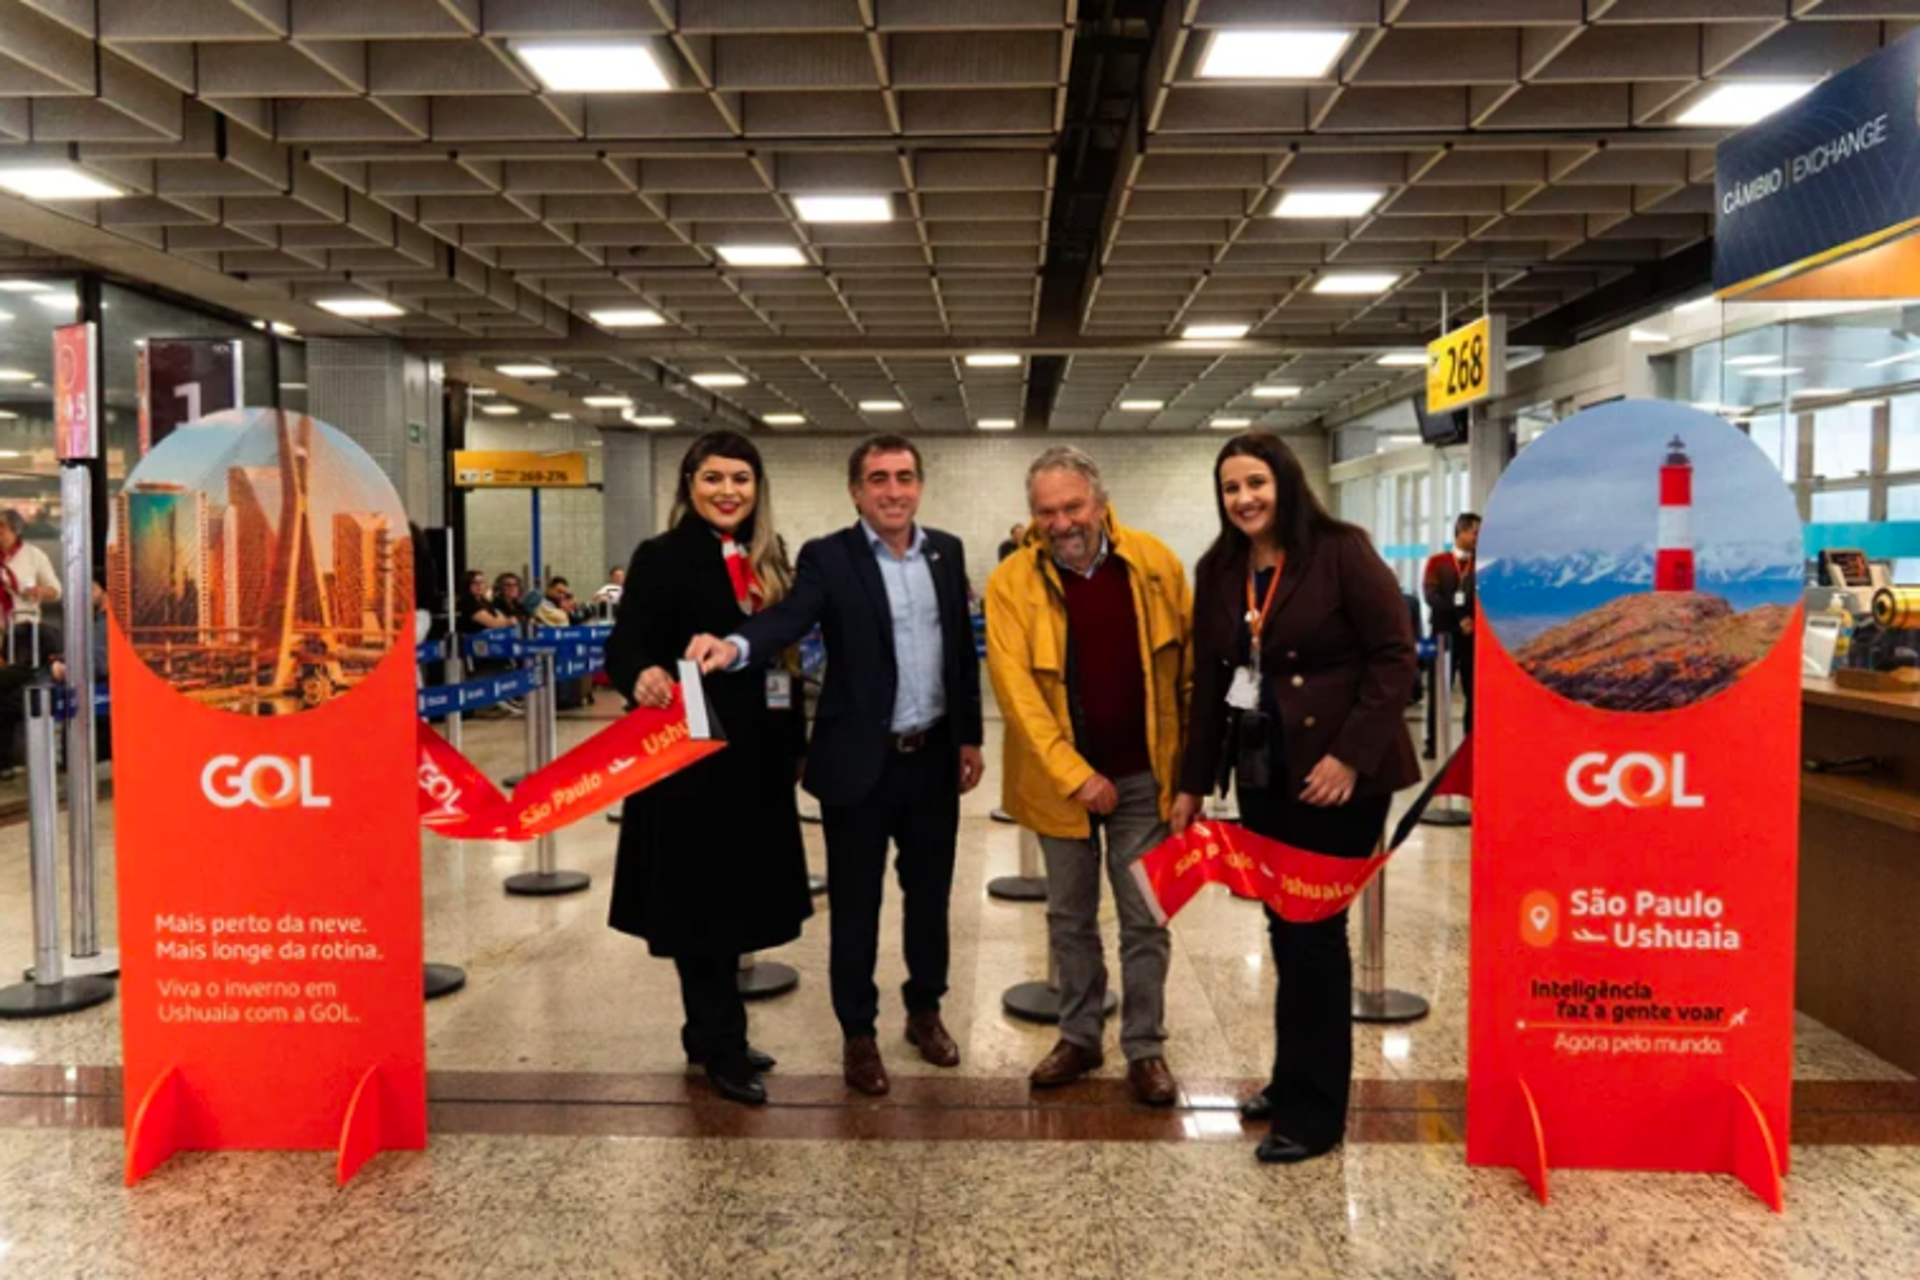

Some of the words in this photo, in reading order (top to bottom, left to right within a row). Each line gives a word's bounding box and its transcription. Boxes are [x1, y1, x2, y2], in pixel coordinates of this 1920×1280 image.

[1792, 113, 1888, 184] EXCHANGE
[1447, 334, 1484, 396] 268
[201, 755, 331, 807] GOL
[417, 762, 463, 814] GOL
[1565, 752, 1705, 807] GOL
[519, 802, 551, 828] São
[552, 771, 602, 811] Paulo
[1279, 873, 1356, 901] shuaia
[1570, 889, 1627, 916] São
[1635, 891, 1723, 918] Paulo
[155, 914, 206, 933] Mais
[212, 914, 272, 936] perto
[277, 914, 304, 933] da
[310, 919, 367, 933] neve.
[1613, 923, 1740, 949] Ushuaia
[156, 941, 207, 960] Mais
[213, 941, 273, 964] longe
[279, 942, 306, 960] da
[312, 942, 384, 960] rotina.
[158, 980, 202, 997] Viva
[206, 984, 219, 997] o
[225, 980, 300, 997] inverno
[305, 983, 337, 997] em
[1531, 980, 1653, 1001] Inteligência
[158, 1004, 240, 1022] Ushuaia
[245, 1008, 288, 1023] com
[293, 1008, 305, 1022] a
[310, 1004, 360, 1023] GOL.
[1557, 1000, 1589, 1018] faz
[1594, 1005, 1606, 1018] a
[1612, 1004, 1672, 1023] gente
[1677, 1006, 1723, 1020] voar
[1554, 1033, 1607, 1053] Agora
[1612, 1034, 1651, 1055] pelo
[1654, 1035, 1723, 1054] mundo.
